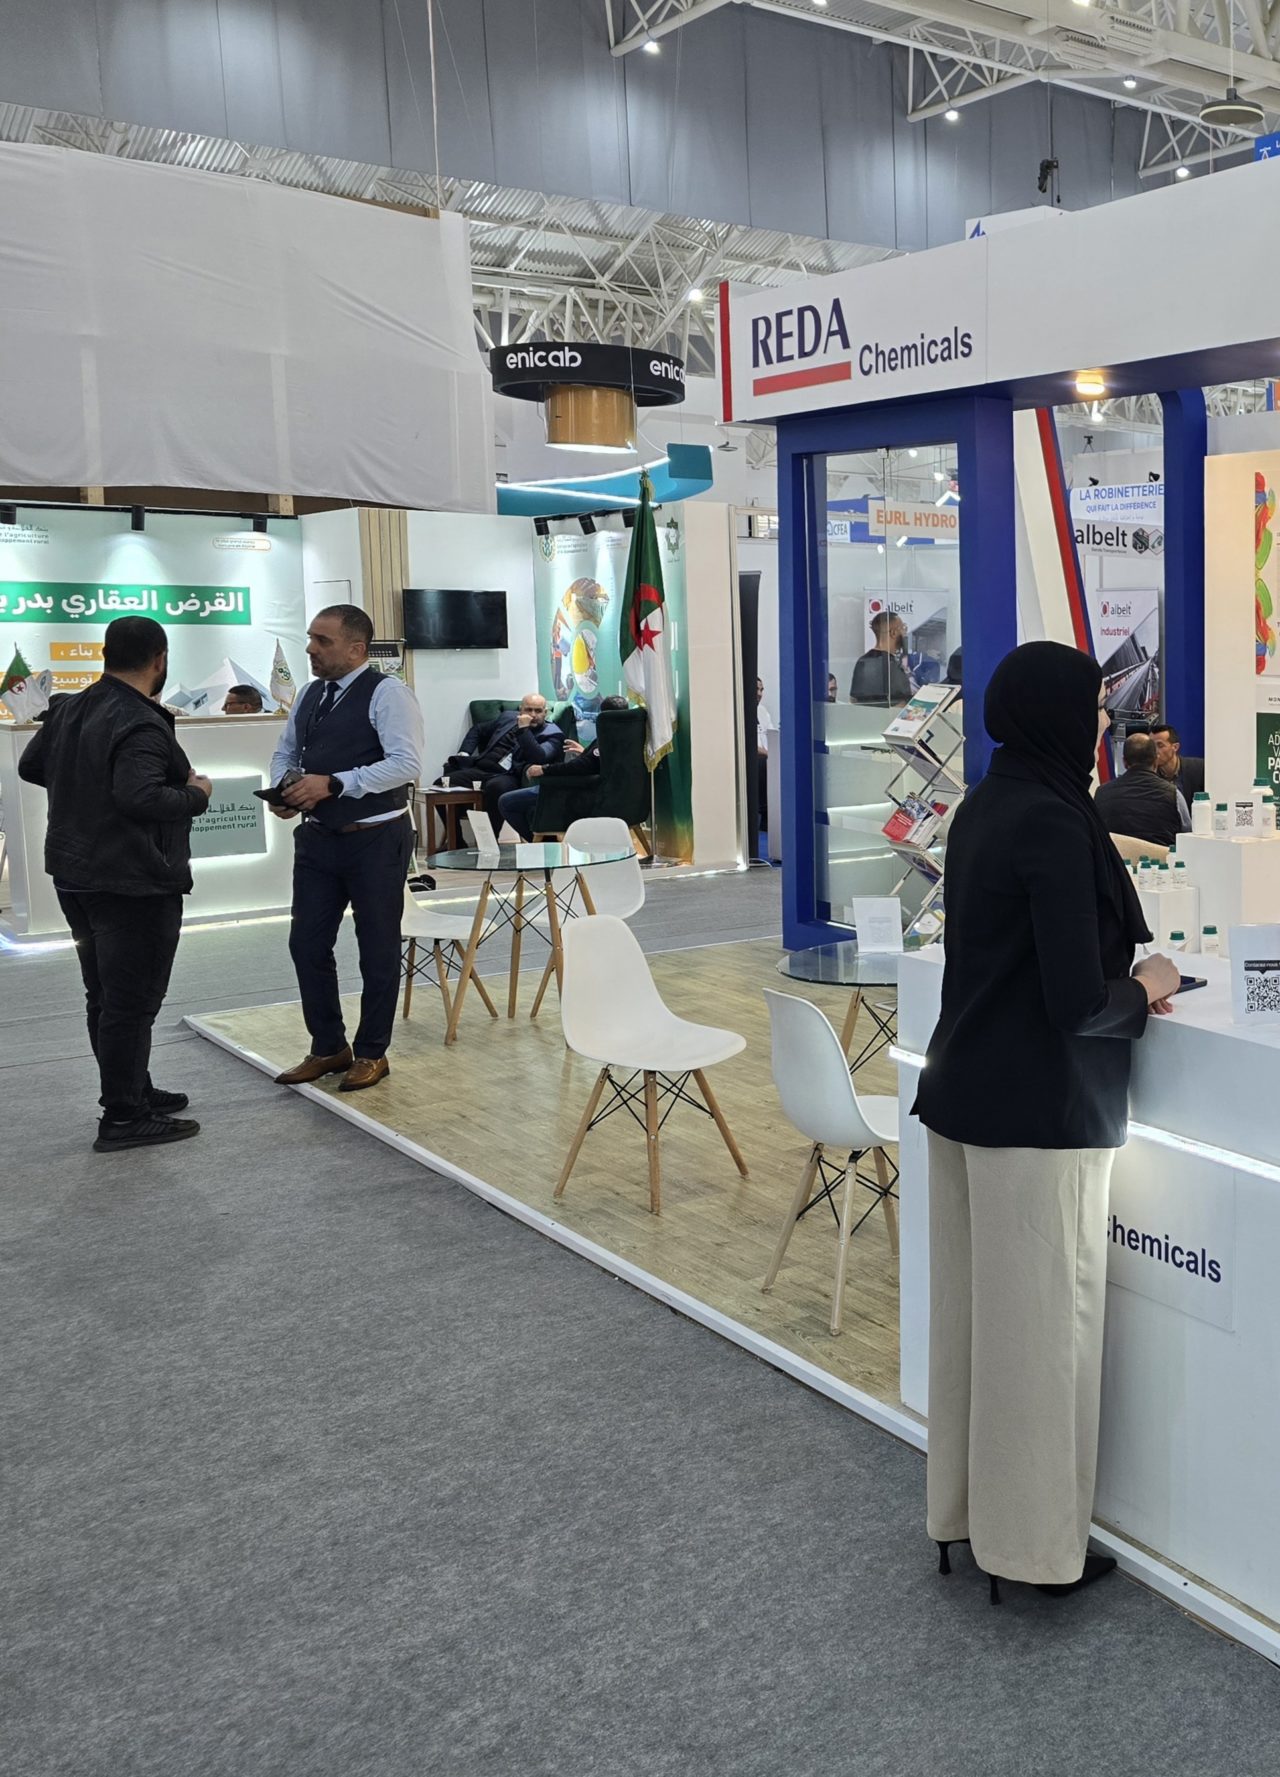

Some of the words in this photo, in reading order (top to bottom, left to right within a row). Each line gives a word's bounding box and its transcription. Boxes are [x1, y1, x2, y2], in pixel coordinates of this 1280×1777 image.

[752, 297, 851, 368] REDA
[859, 326, 973, 376] Chemicals
[506, 346, 582, 369] enicab
[1080, 489, 1091, 500] LA
[1094, 484, 1164, 499] ROBINETTERIE
[1087, 505, 1097, 513] QUI
[1098, 504, 1109, 512] FAIT
[1112, 503, 1118, 511] LA
[914, 513, 957, 528] HYDRO
[1076, 524, 1127, 547] albelt
[11, 592, 54, 616] بدر
[62, 589, 158, 618] العقاري
[165, 592, 244, 617] القرض
[1110, 604, 1131, 615] albelt
[192, 824, 235, 832] loppement
[199, 815, 256, 824] l'agriculture
